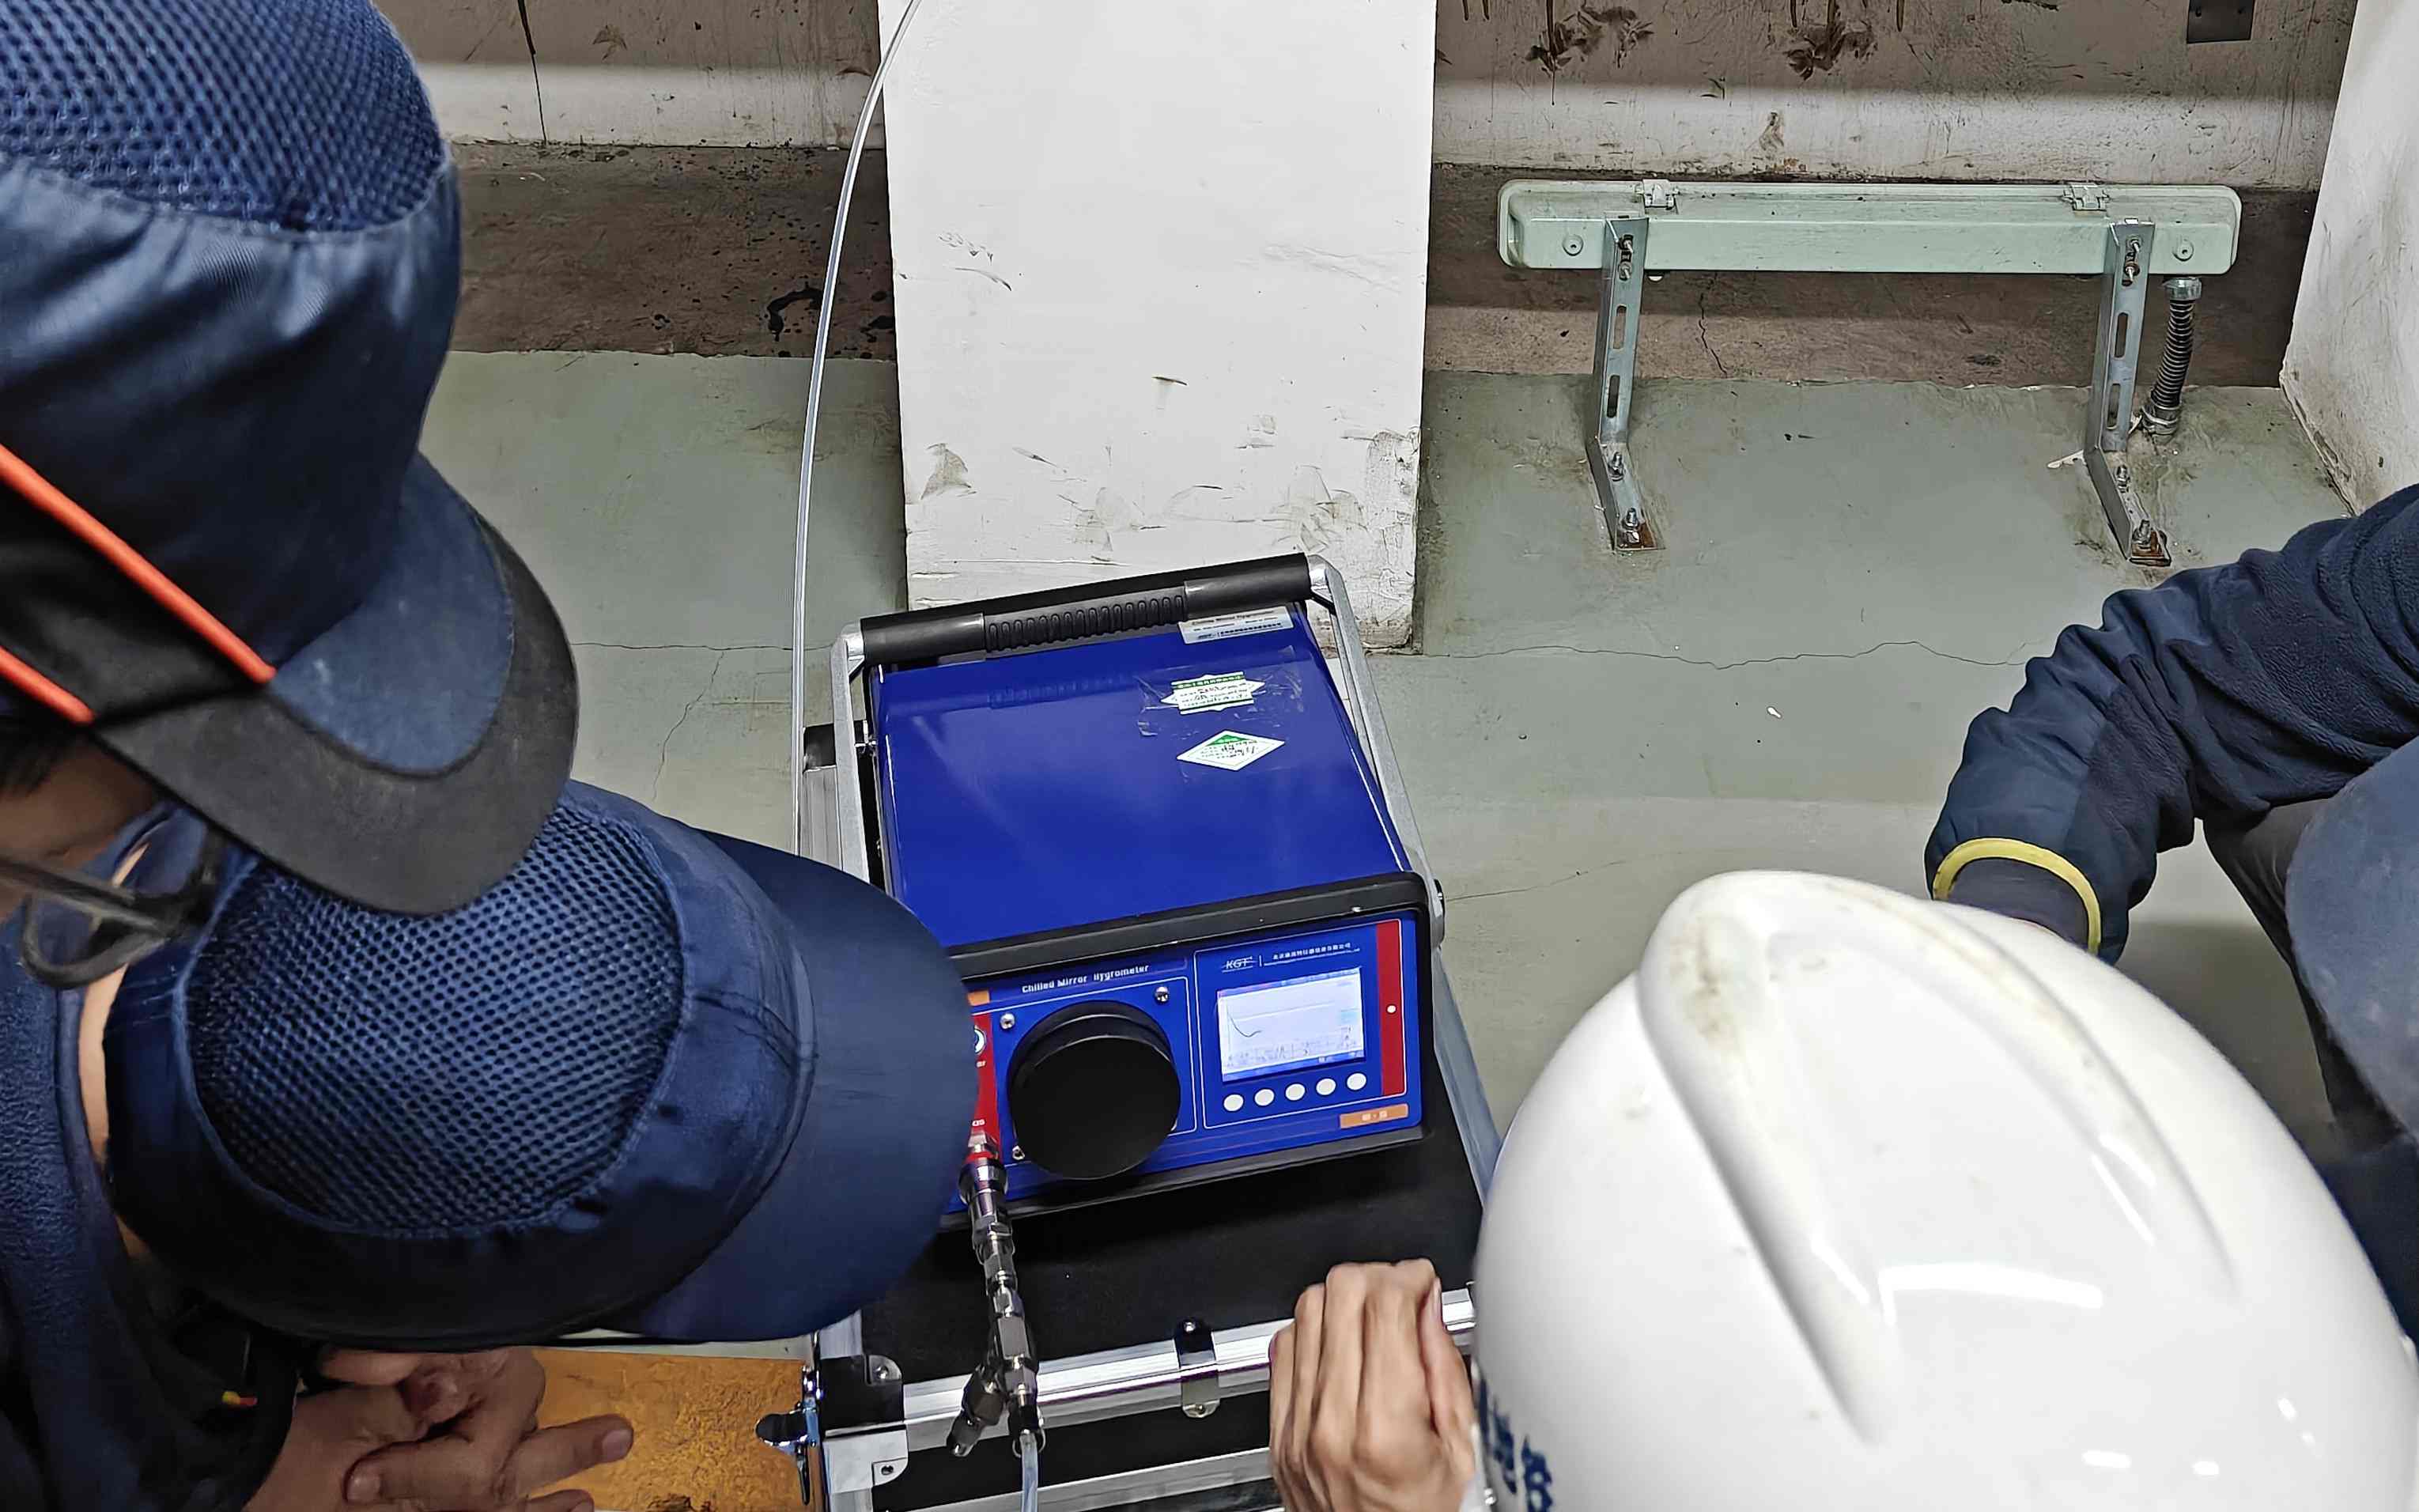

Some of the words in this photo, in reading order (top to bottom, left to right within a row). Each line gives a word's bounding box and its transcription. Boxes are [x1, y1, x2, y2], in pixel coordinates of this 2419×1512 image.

[1022, 981, 1055, 993] Chilled
[1056, 974, 1087, 988] Mirror
[1094, 964, 1149, 982] Hygrometer
